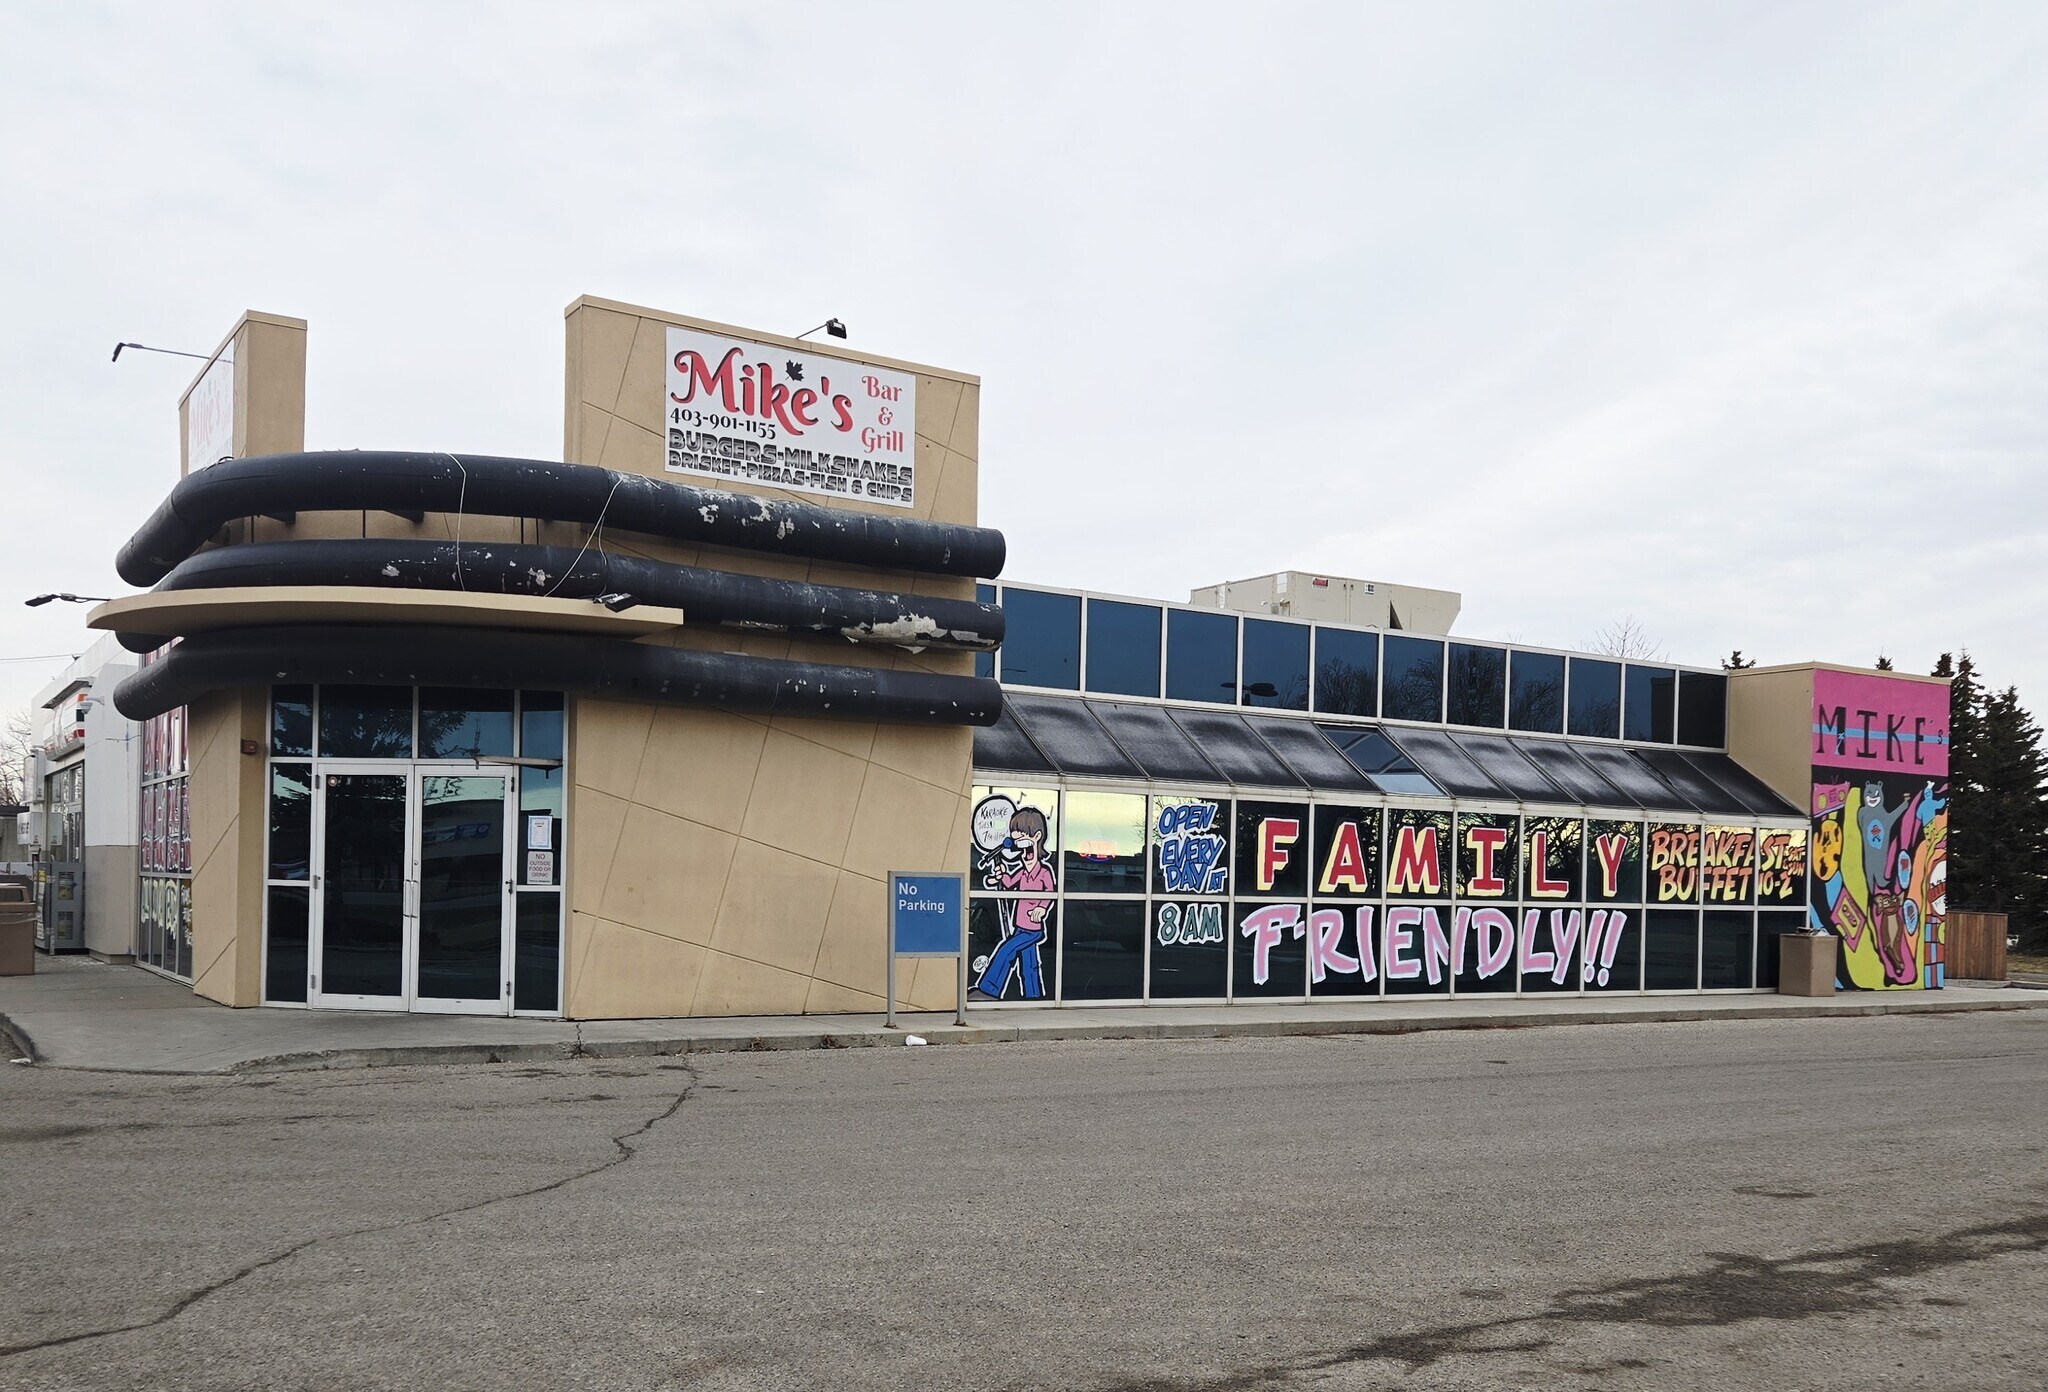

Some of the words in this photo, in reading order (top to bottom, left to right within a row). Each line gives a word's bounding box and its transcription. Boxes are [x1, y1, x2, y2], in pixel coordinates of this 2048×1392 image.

[671, 347, 854, 436] Mike's
[861, 375, 902, 402] Bar
[670, 407, 776, 440] 403-901-1155
[878, 406, 893, 426] &
[861, 426, 904, 454] Grill
[866, 482, 912, 502] CHIPS
[980, 806, 1008, 819] KARAOKE
[1157, 803, 1216, 836] OPEN
[1161, 836, 1225, 867] EVERY
[1257, 817, 1628, 898] FAMILY
[1651, 830, 1791, 871] BREAKFAST
[1788, 846, 1806, 861] SAT
[1165, 862, 1207, 892] DAY
[1208, 869, 1226, 891] AT
[1658, 864, 1753, 901] BUFFET
[1787, 862, 1805, 877] SUN
[898, 882, 918, 895] No
[1758, 870, 1793, 899] 10-2
[898, 899, 945, 914] Parking
[1158, 904, 1179, 943] 8
[1181, 904, 1222, 943] AM
[1240, 904, 1628, 987] FRIENDLY!!
